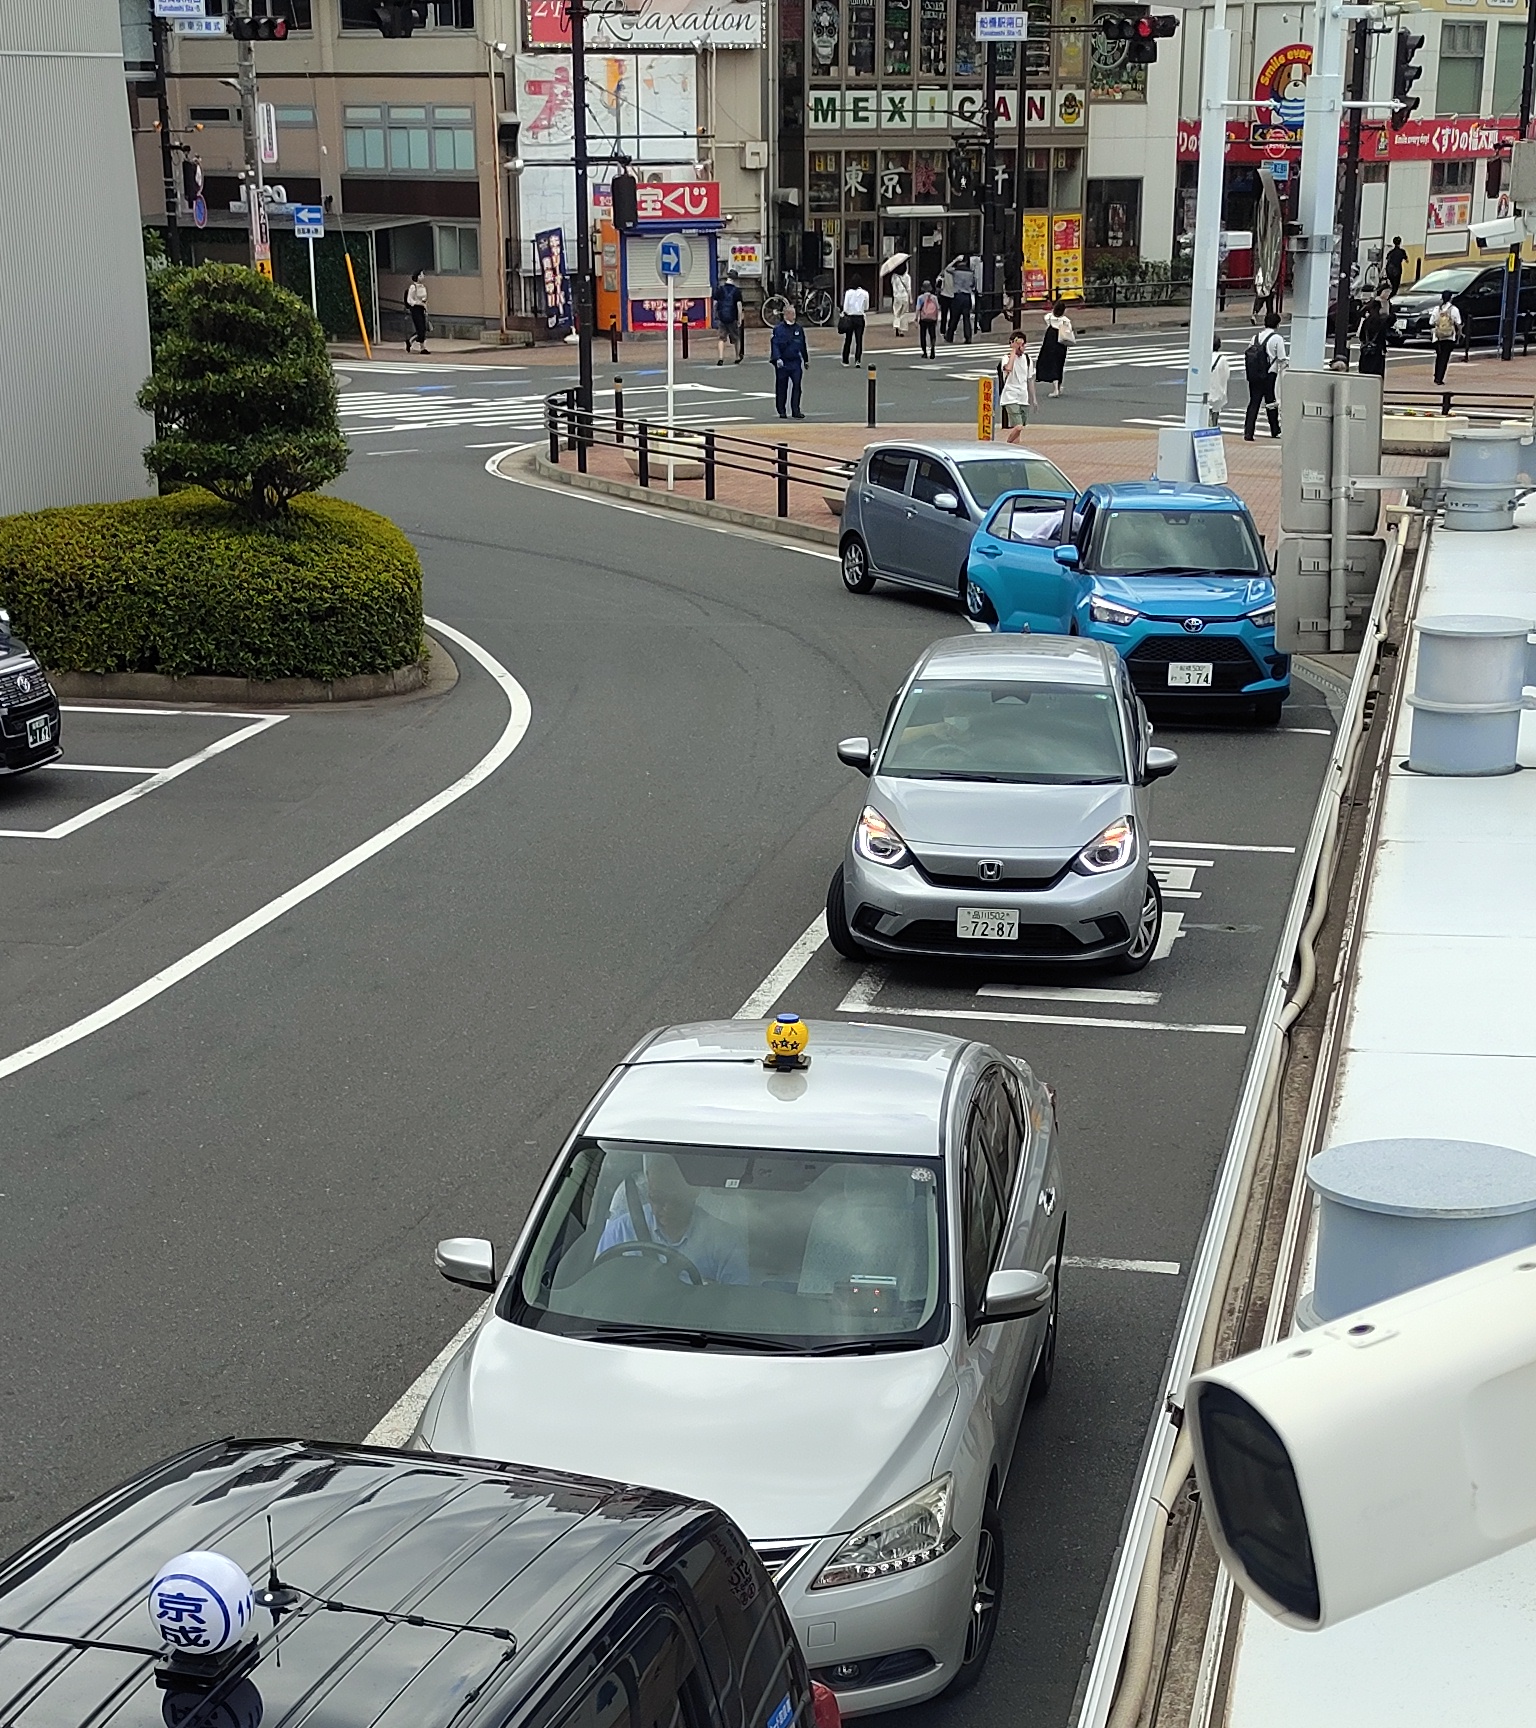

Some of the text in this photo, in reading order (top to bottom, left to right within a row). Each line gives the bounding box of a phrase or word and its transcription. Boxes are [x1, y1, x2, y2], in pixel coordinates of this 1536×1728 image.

[979, 17, 1024, 28] 船橋駅南口
[1260, 54, 1286, 86] Smile
[813, 96, 1046, 123] MEXICAN
[635, 186, 709, 219] 宝くじ
[970, 920, 1016, 938] 72-87
[156, 1591, 211, 1648] 京成
